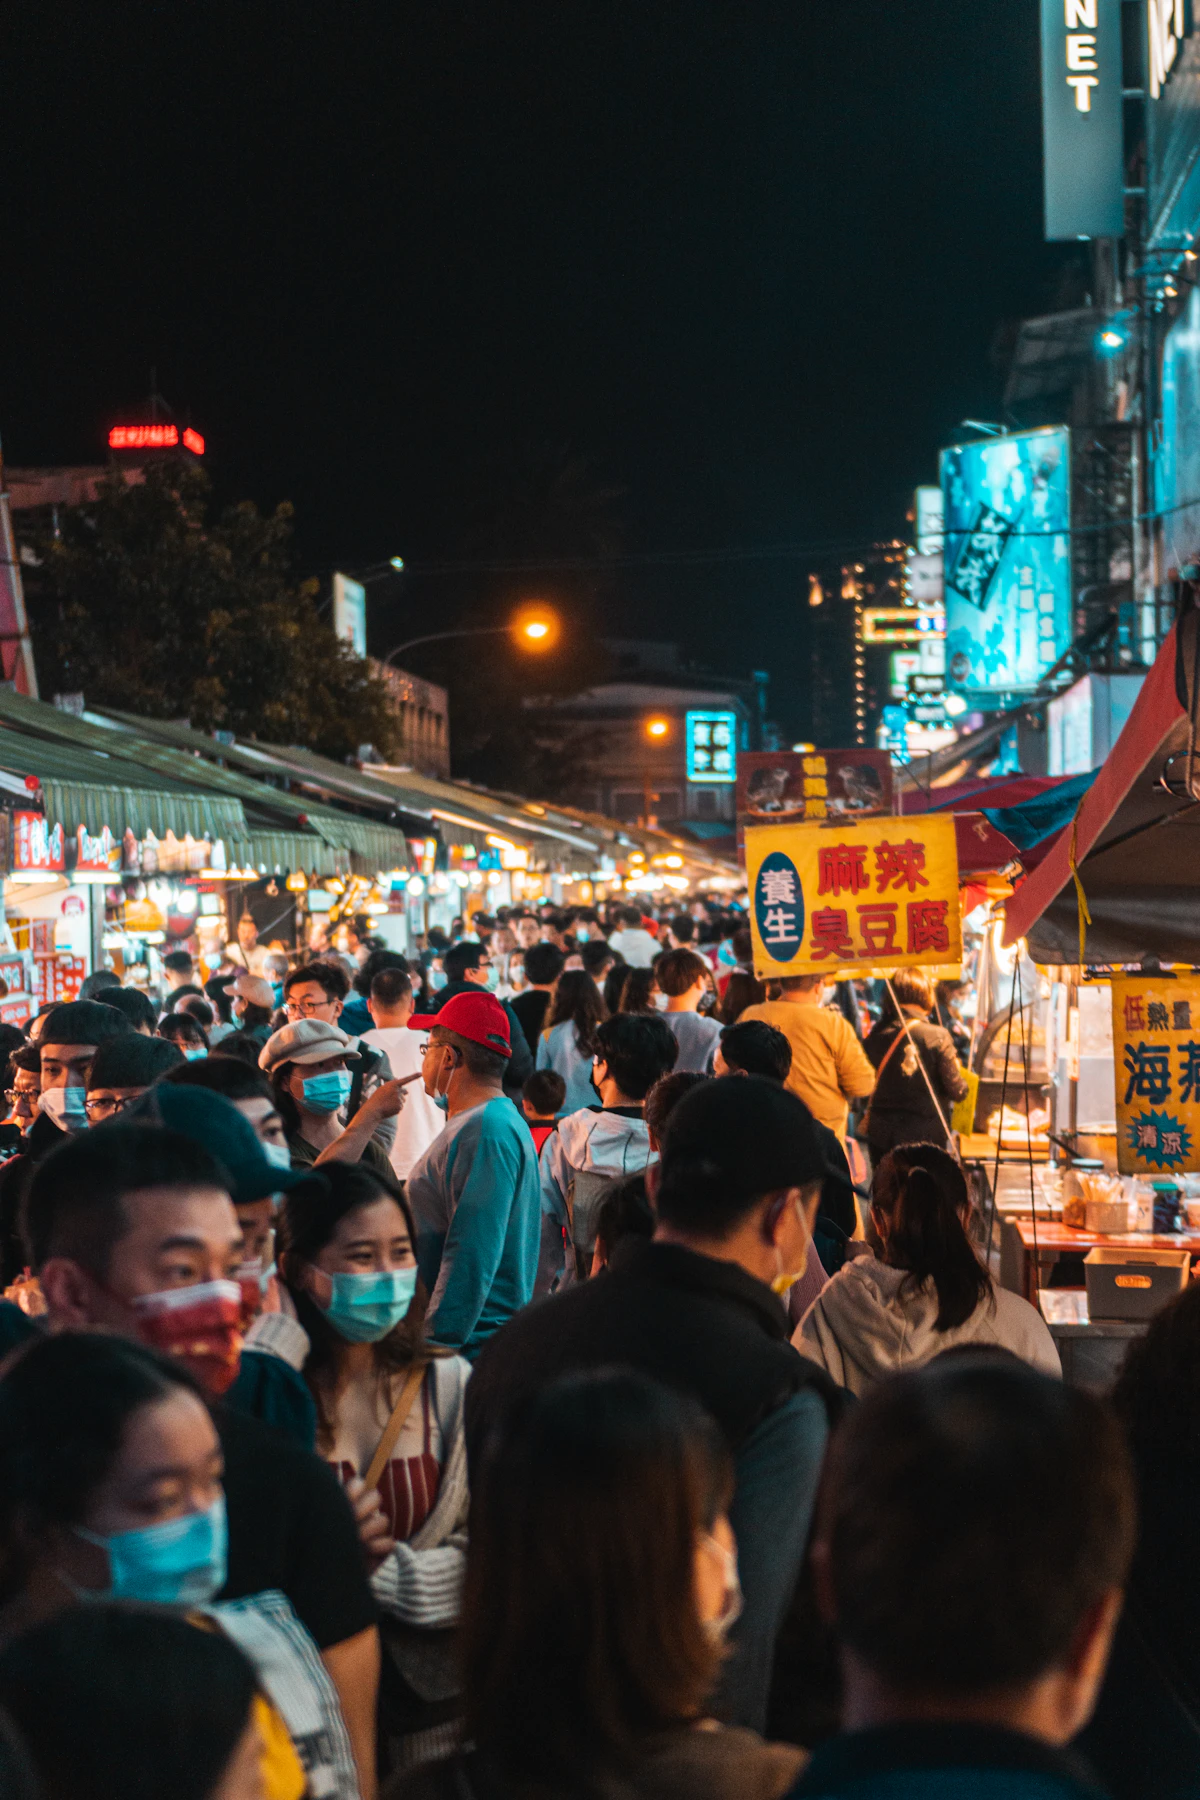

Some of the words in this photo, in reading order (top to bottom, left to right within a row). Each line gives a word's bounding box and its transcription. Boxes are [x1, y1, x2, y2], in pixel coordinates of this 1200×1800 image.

[1064, 0, 1099, 113] NET
[817, 838, 929, 897] 麻辣
[761, 868, 799, 944] 養生
[810, 899, 950, 960] 臭豆腐
[1123, 995, 1192, 1032] 低熱量
[1137, 1125, 1182, 1155] 清涼
